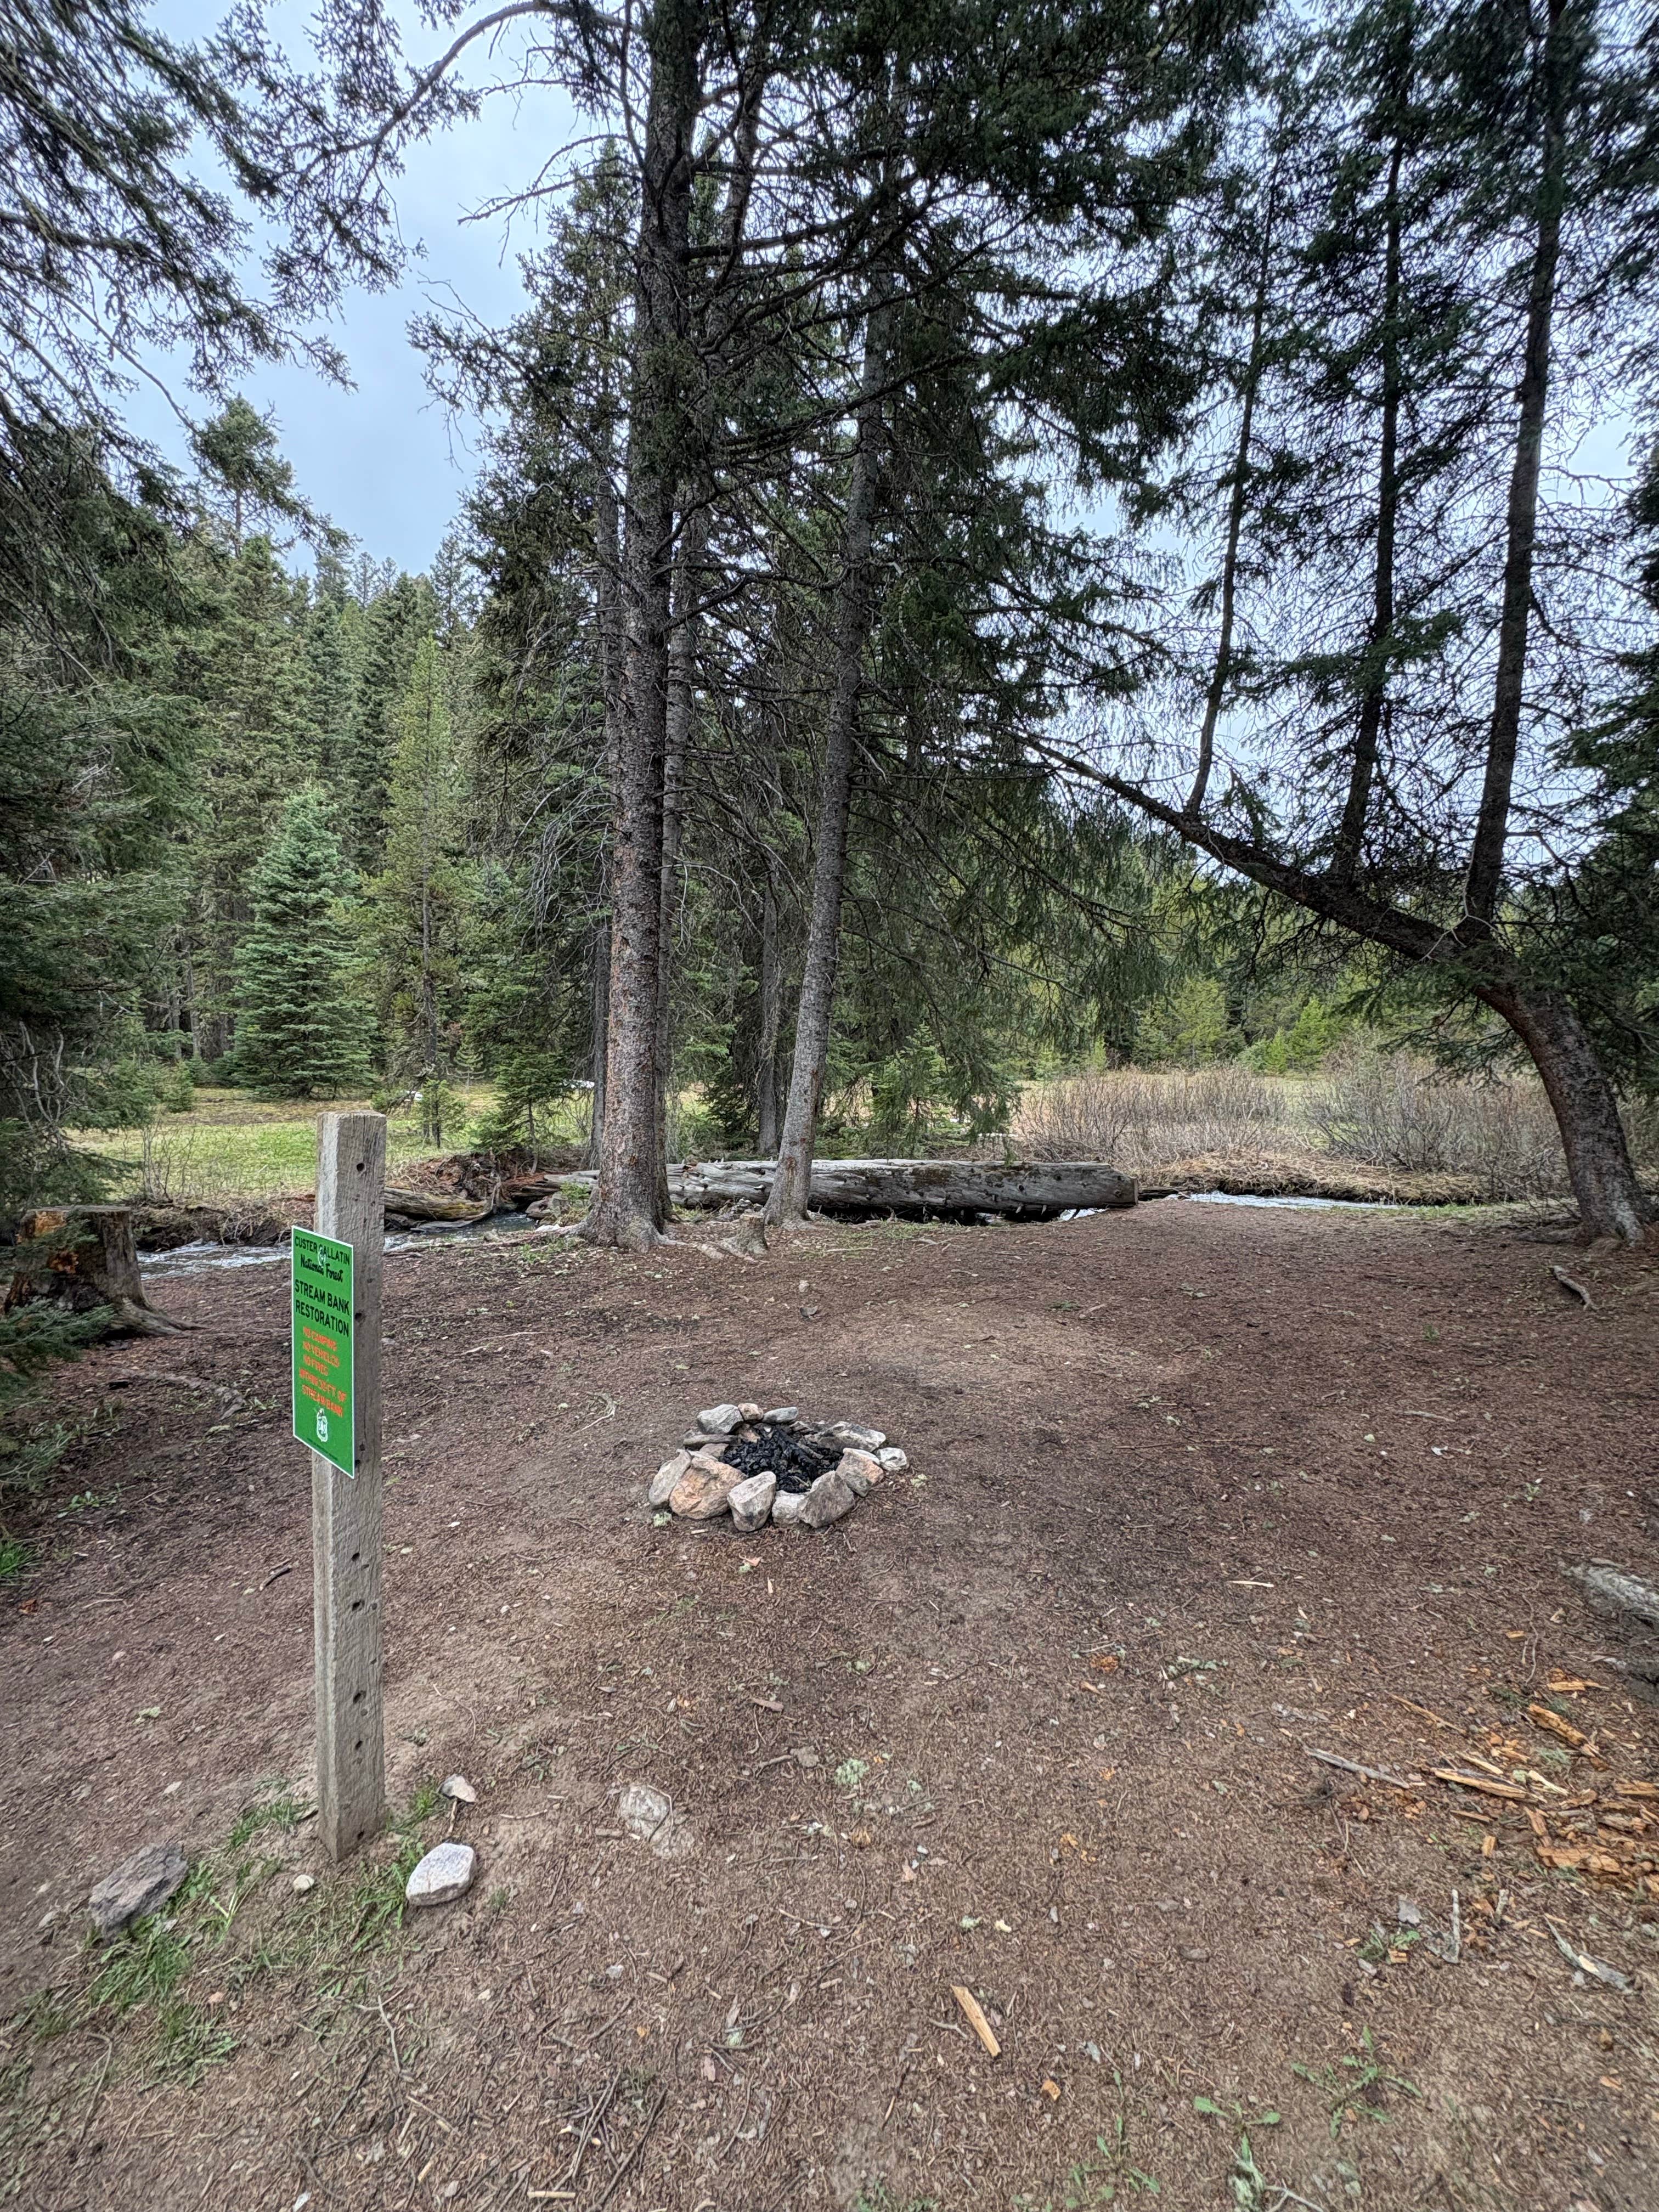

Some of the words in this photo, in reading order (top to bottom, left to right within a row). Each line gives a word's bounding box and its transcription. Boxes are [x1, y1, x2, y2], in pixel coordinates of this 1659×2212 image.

[295, 1236, 317, 1253] CUSTER
[319, 1244, 349, 1265] GALLATIN
[300, 1254, 324, 1276] National
[325, 1263, 343, 1283] Forest
[295, 1279, 325, 1304] STREAM
[327, 1293, 349, 1316] BANK
[296, 1299, 348, 1337] RESTORATION
[303, 1327, 311, 1338] NO
[312, 1330, 337, 1351] CAMPING
[303, 1340, 310, 1352] NO
[312, 1345, 340, 1368] VEHICLES
[304, 1355, 310, 1365] NO
[312, 1358, 328, 1376] FIRES
[302, 1384, 325, 1405] STREAM
